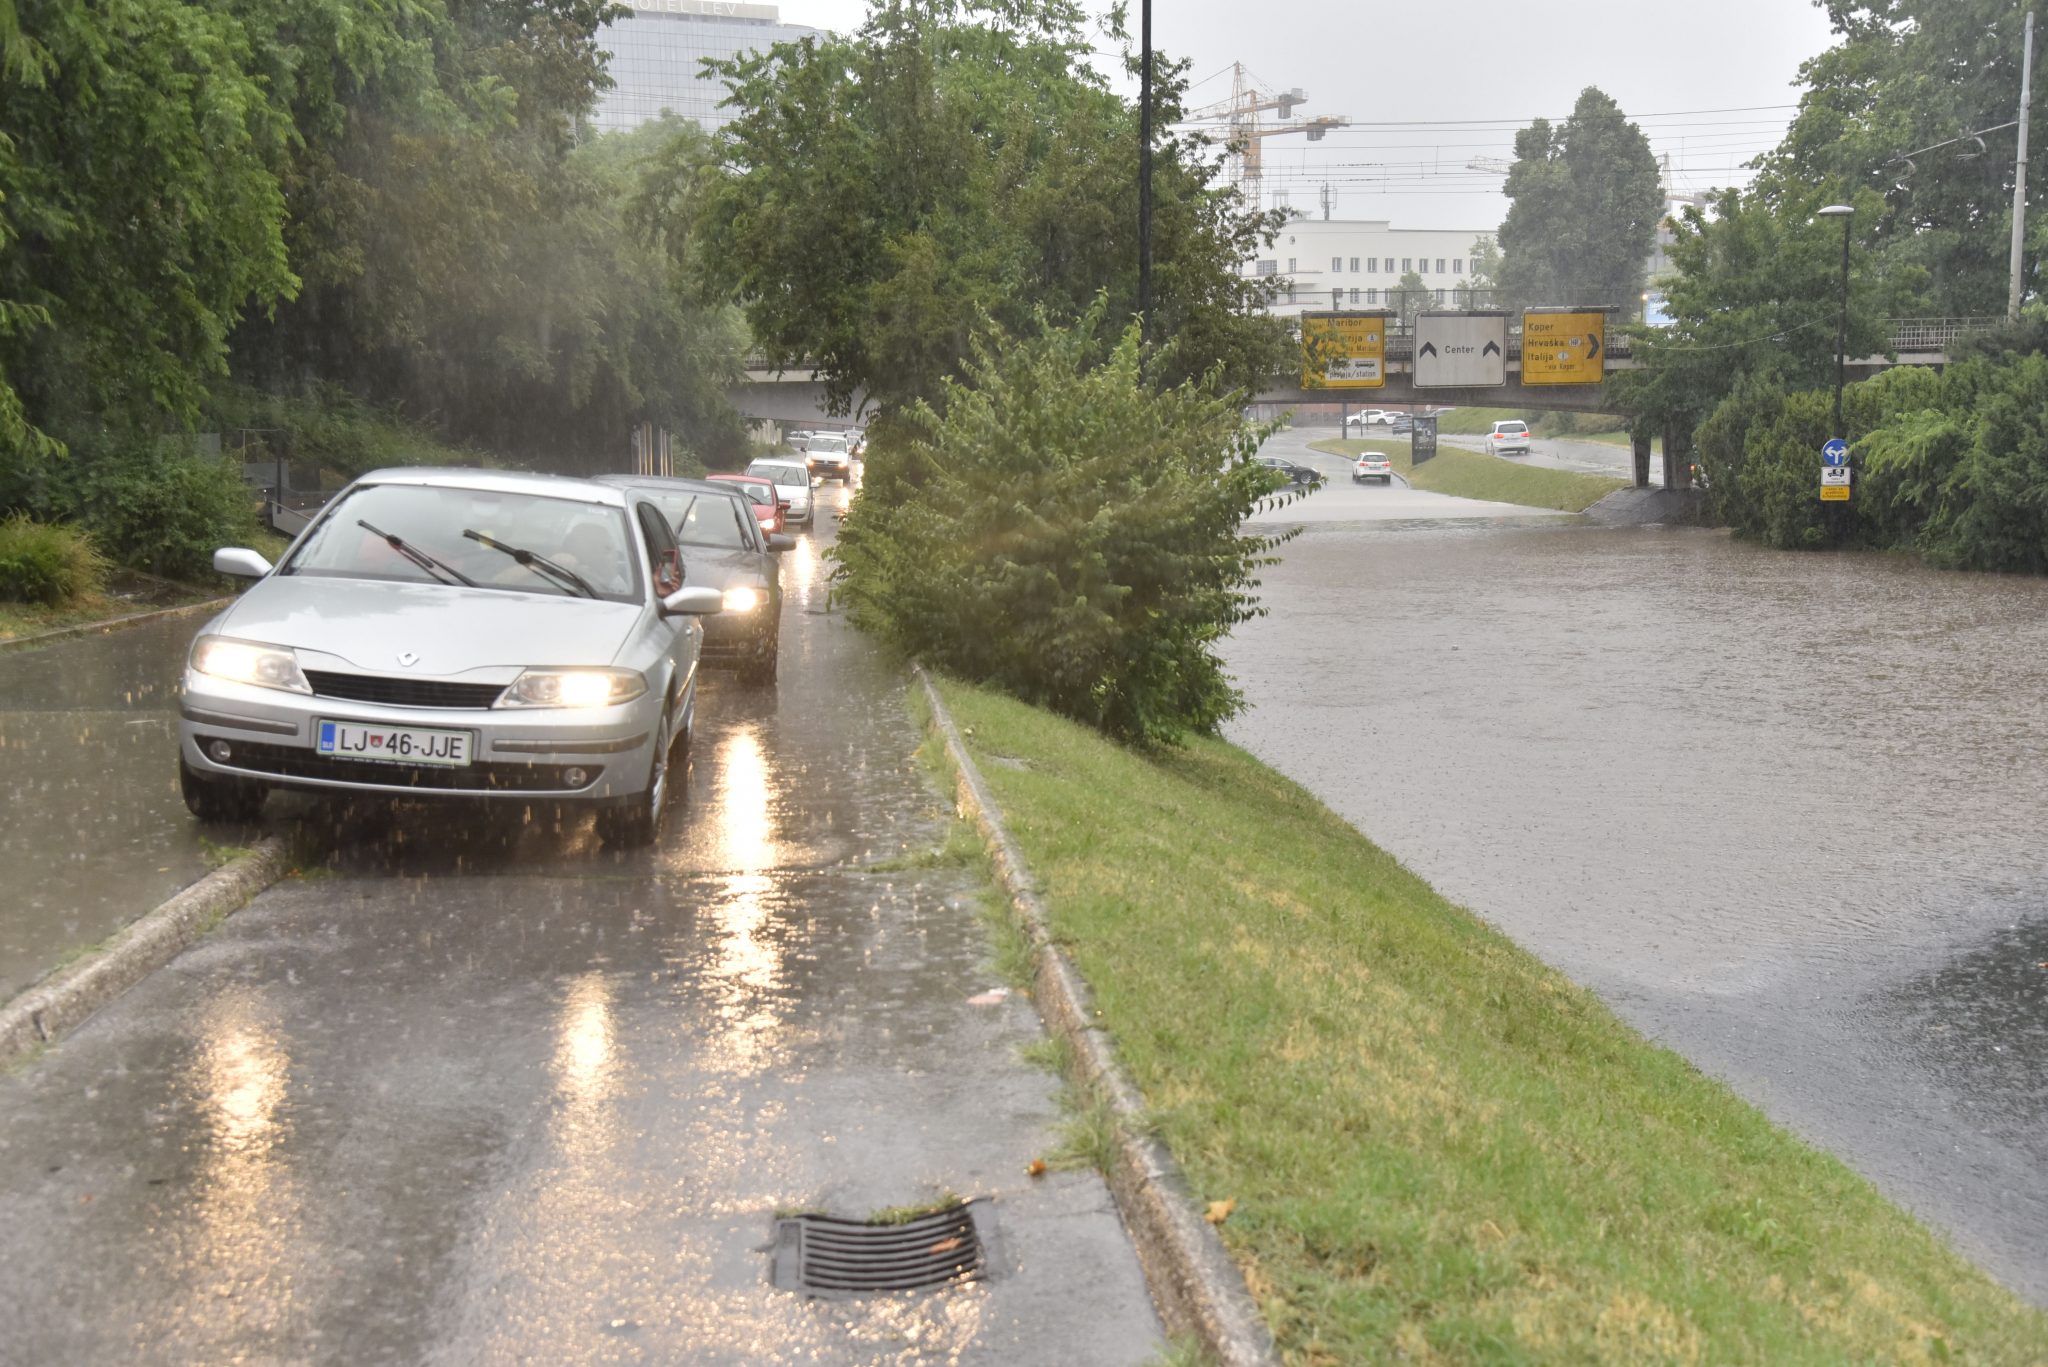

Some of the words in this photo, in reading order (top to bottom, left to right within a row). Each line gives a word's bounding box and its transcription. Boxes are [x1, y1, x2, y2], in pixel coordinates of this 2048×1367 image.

[700, 1, 736, 15] LEV
[1328, 318, 1362, 327] Maribor
[1528, 322, 1554, 332] Koper
[1528, 338, 1564, 347] Hrvaška
[1445, 345, 1474, 354] Center
[1528, 352, 1554, 362] Italija
[340, 728, 368, 751] LJ
[386, 733, 464, 759] 46-JJE
